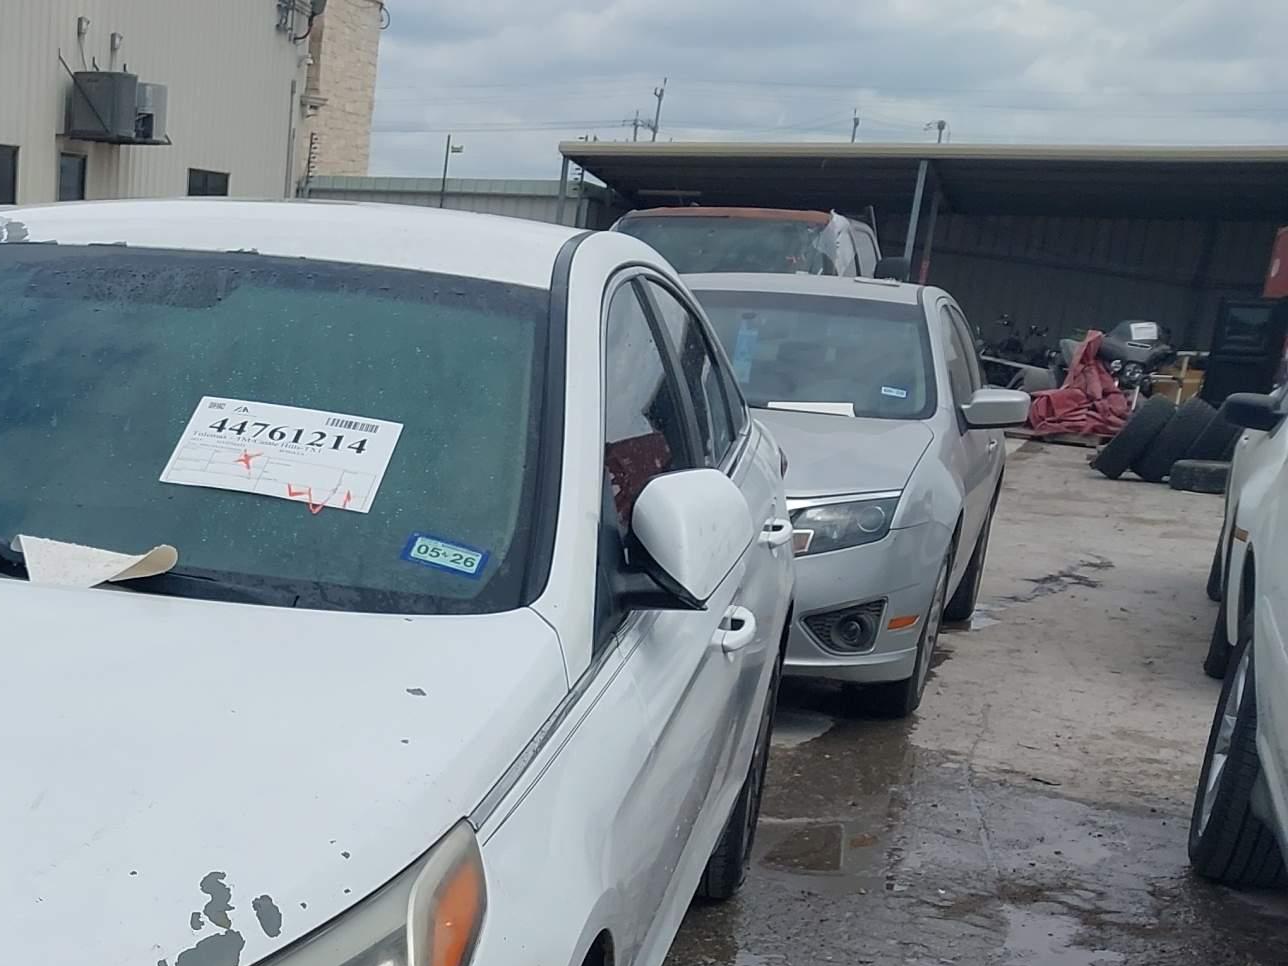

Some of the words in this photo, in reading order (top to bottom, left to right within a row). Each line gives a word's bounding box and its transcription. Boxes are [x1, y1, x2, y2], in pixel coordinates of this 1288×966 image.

[208, 417, 368, 454] 44761214
[417, 544, 442, 558] 05
[449, 553, 476, 568] 26
